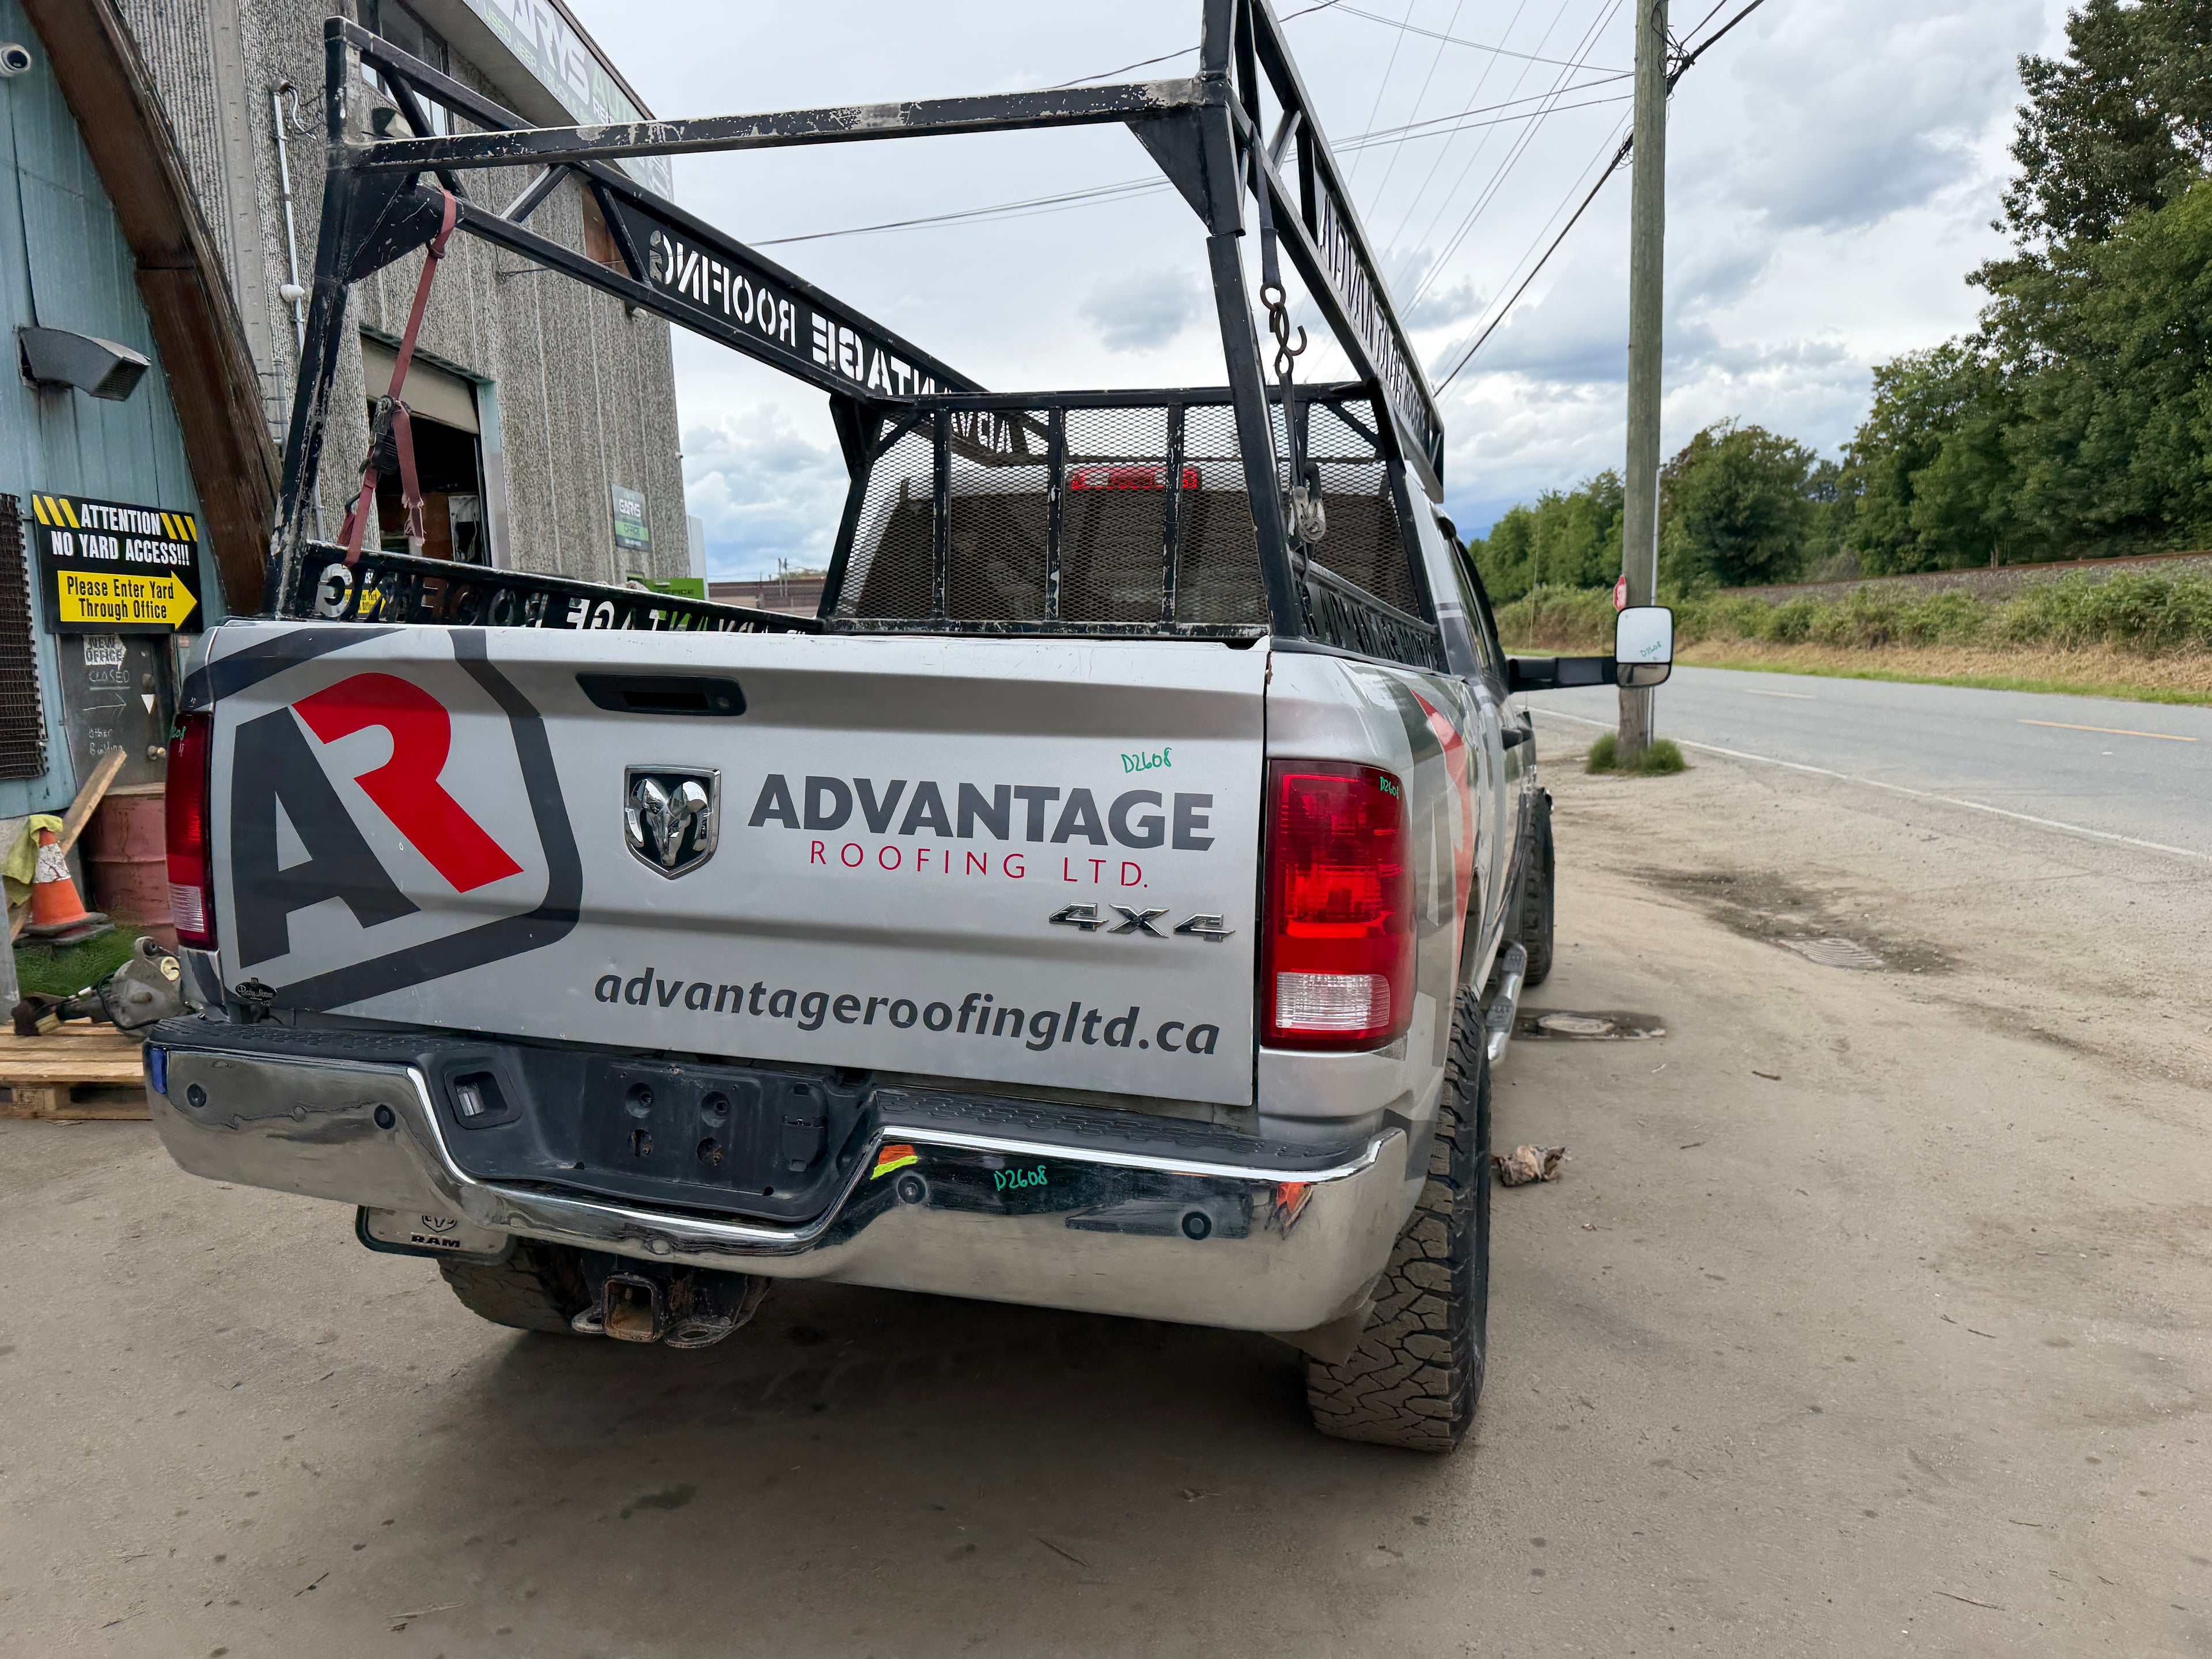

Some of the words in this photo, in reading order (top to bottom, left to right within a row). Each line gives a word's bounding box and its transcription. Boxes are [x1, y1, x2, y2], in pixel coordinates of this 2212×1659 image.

[483, 1, 512, 43] USED
[81, 503, 161, 536] ATTENTION
[51, 531, 74, 556] NO
[78, 533, 119, 559] YARD
[126, 539, 190, 566] ACCESS!!!
[67, 576, 108, 596] Please
[113, 578, 145, 598] Enter
[149, 581, 174, 599] Yard
[78, 599, 128, 620] Through
[134, 600, 167, 619] Office
[1121, 747, 1172, 773] D2608
[748, 773, 1215, 851] ADVANTAGE
[810, 840, 1025, 879] ROOFING
[1063, 857, 1149, 888] LTD.
[1048, 902, 1236, 942] 4X4
[594, 967, 1219, 1055] advantageroofingltd.ca
[994, 1165, 1048, 1191] D2608
[411, 1233, 461, 1248] RAM
